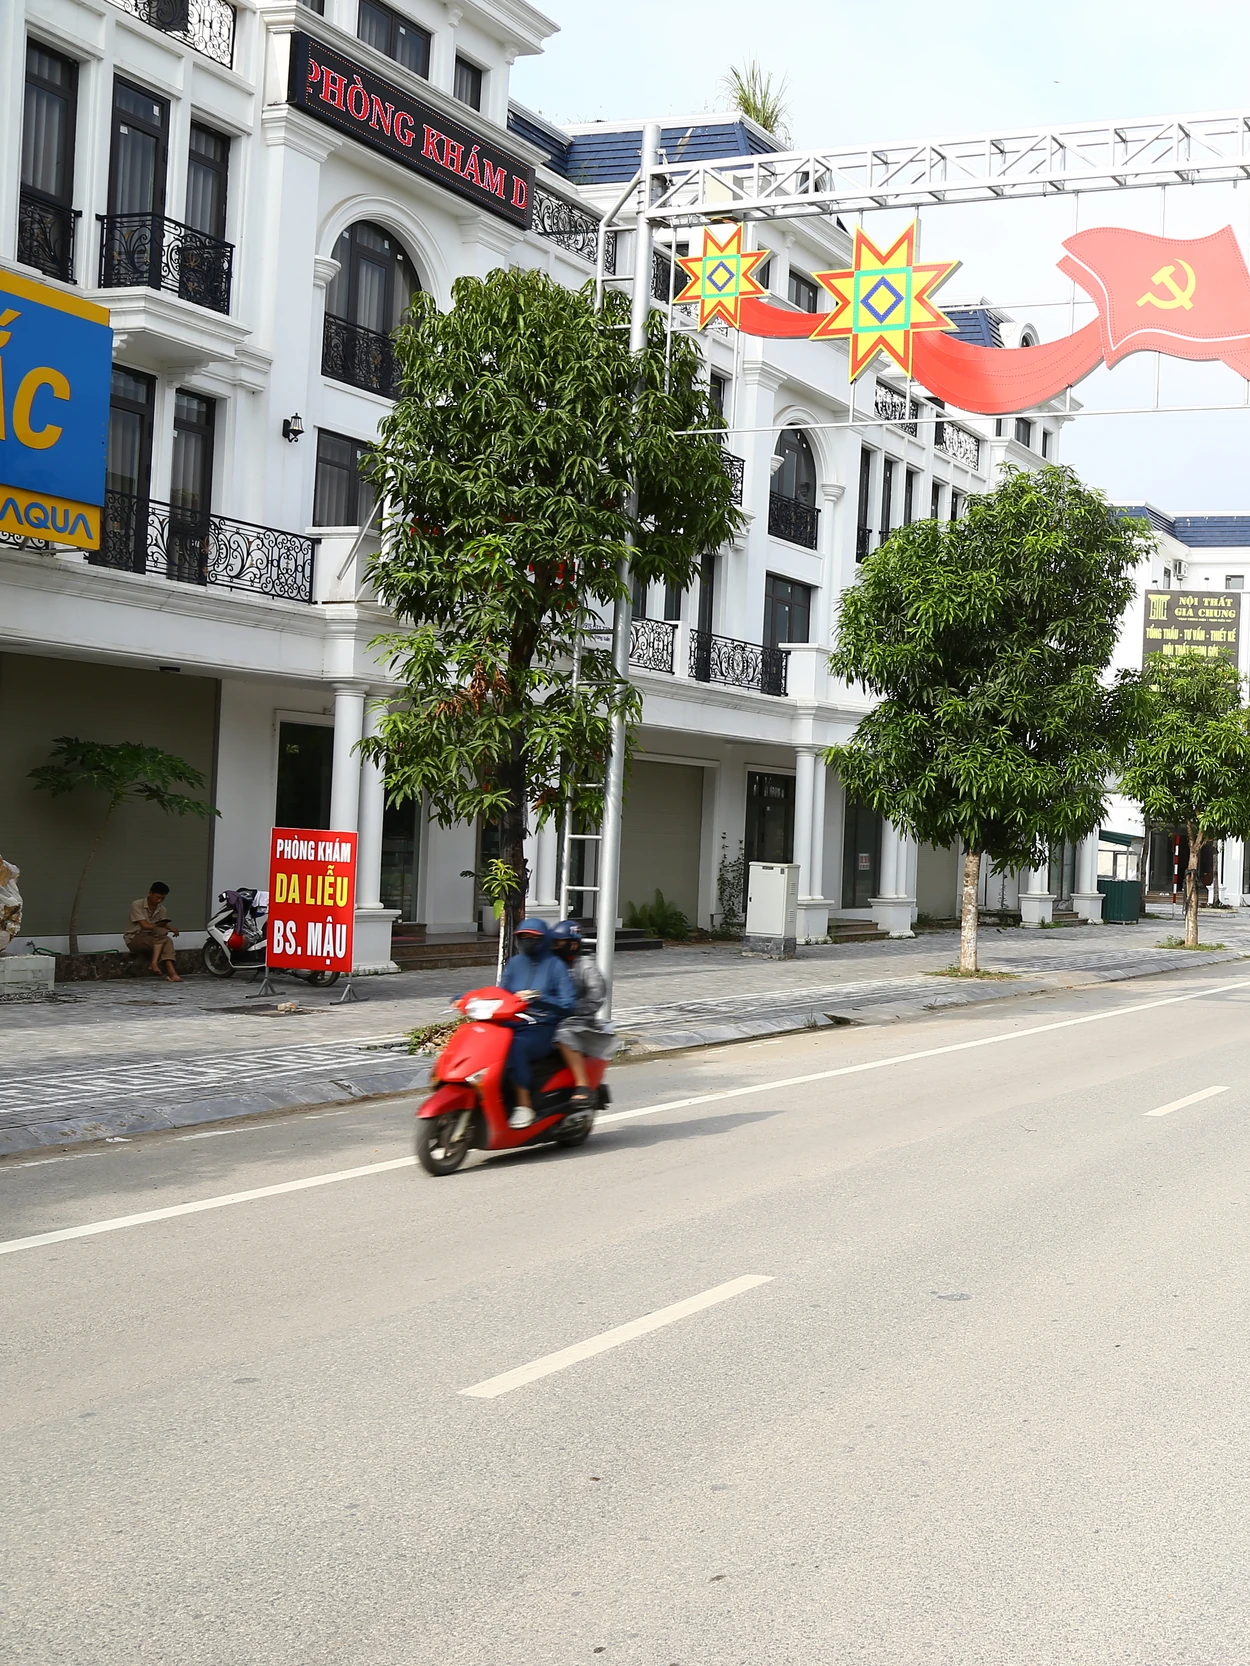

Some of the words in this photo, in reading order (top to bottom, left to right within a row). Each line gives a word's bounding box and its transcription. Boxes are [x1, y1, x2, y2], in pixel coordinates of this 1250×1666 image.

[421, 123, 507, 200] KHÁM
[0, 308, 71, 450] C
[1174, 607, 1194, 617] GIA
[1197, 608, 1236, 618] CHUNG
[1179, 595, 1199, 607] NỘI
[1203, 595, 1233, 607] THẤT
[276, 835, 315, 861] PHÒNG
[317, 837, 351, 863] KHÁM
[275, 872, 301, 904] DA
[305, 865, 349, 908] LIỄU
[273, 919, 302, 955] BS.
[306, 915, 347, 965] MẬU
